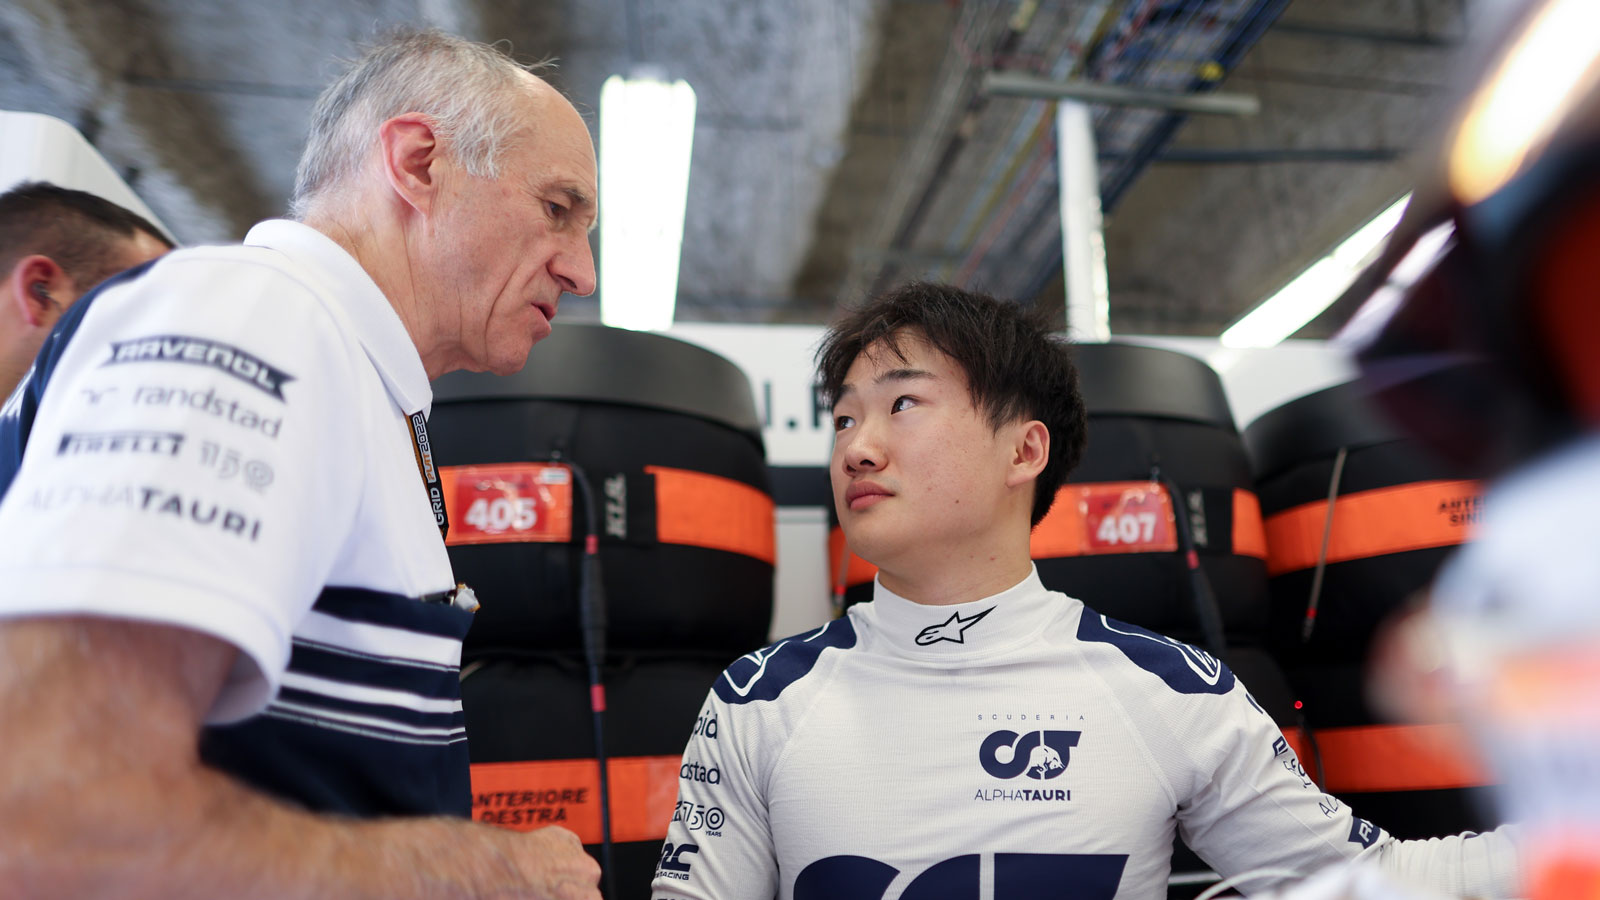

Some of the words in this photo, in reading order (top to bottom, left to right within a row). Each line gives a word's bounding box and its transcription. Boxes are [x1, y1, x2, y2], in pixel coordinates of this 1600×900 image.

[113, 338, 280, 391] RAVENOL
[133, 386, 283, 439] randstad
[56, 430, 186, 456] PIRELLI
[430, 486, 445, 525] GRID
[464, 498, 537, 530] 405
[1096, 512, 1157, 544] 407
[974, 789, 1071, 801] ALPHATAURI
[480, 806, 568, 825] DESTRA
[705, 830, 722, 838] YEARS
